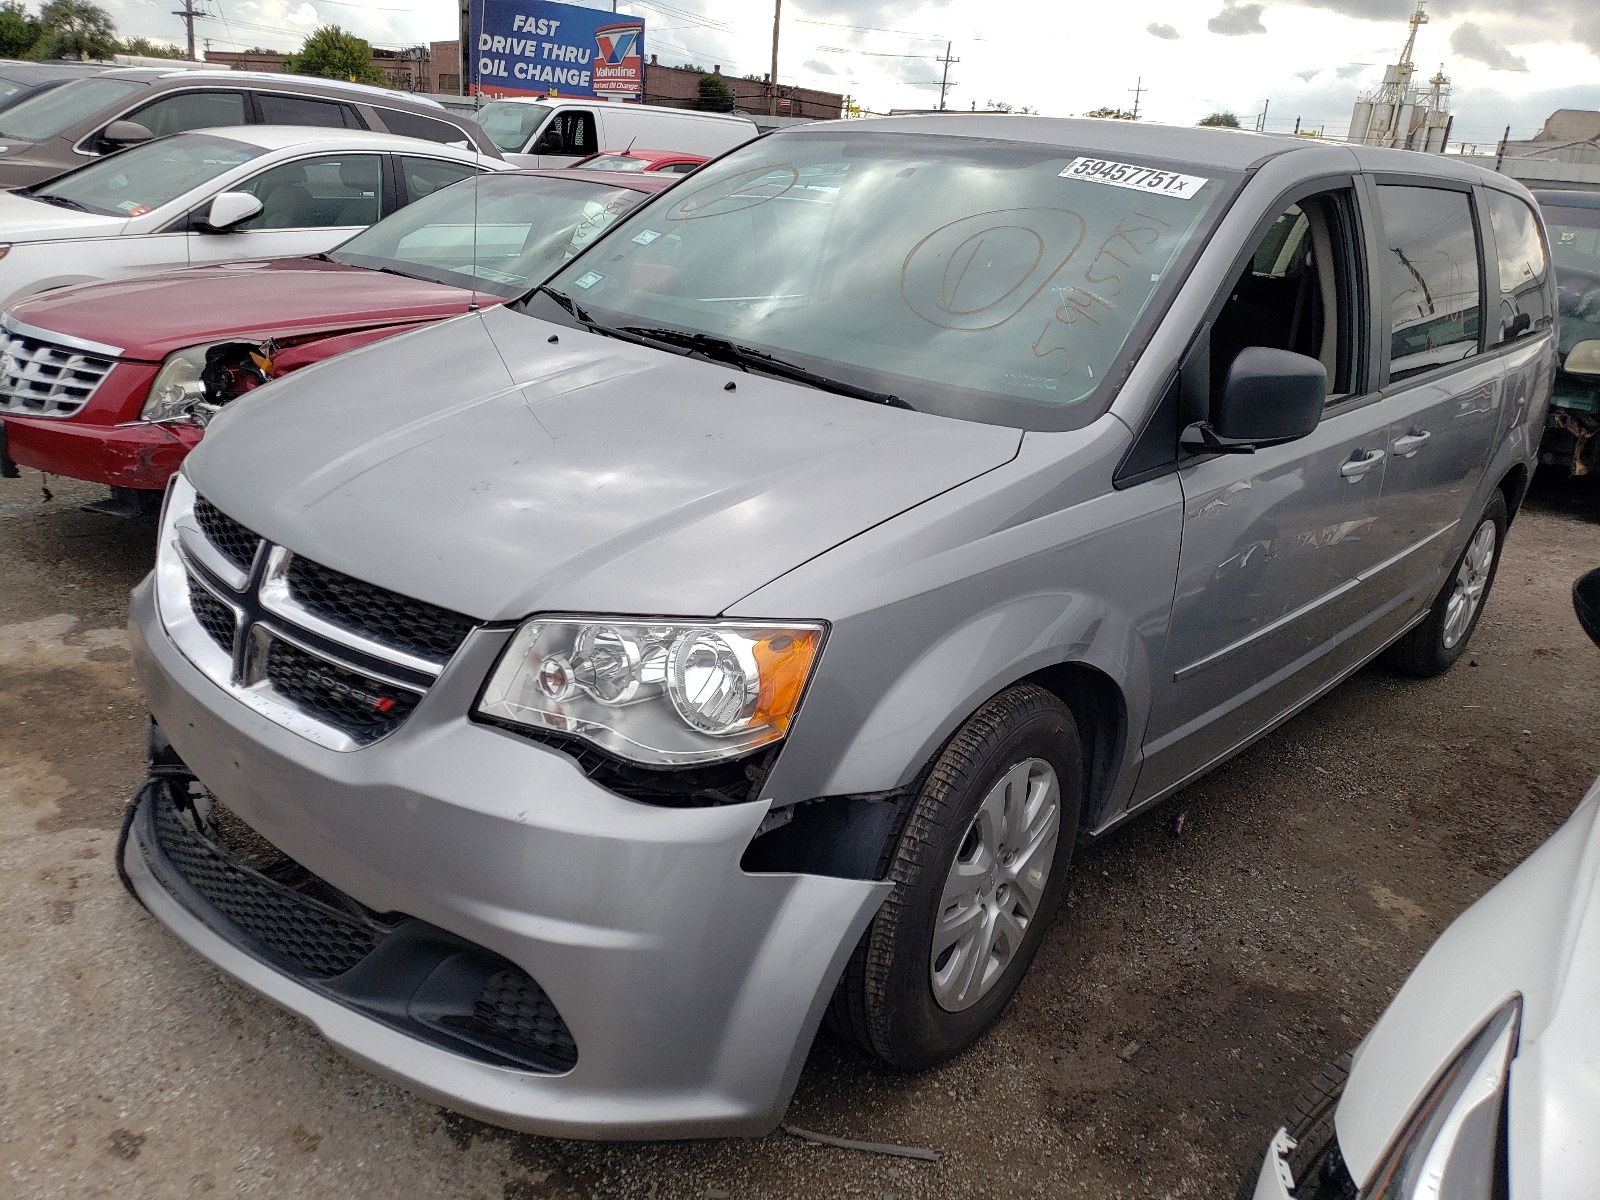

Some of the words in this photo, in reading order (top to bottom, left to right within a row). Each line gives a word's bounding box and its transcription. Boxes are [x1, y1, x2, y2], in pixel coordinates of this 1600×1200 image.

[512, 14, 560, 37] FAST
[478, 33, 538, 58] DRIVE
[542, 42, 591, 65] THRU
[478, 57, 509, 78] OIL
[513, 62, 591, 87] CHANGE
[595, 66, 636, 78] Valvoline
[616, 82, 639, 91] Change
[306, 669, 382, 708] DODGE
